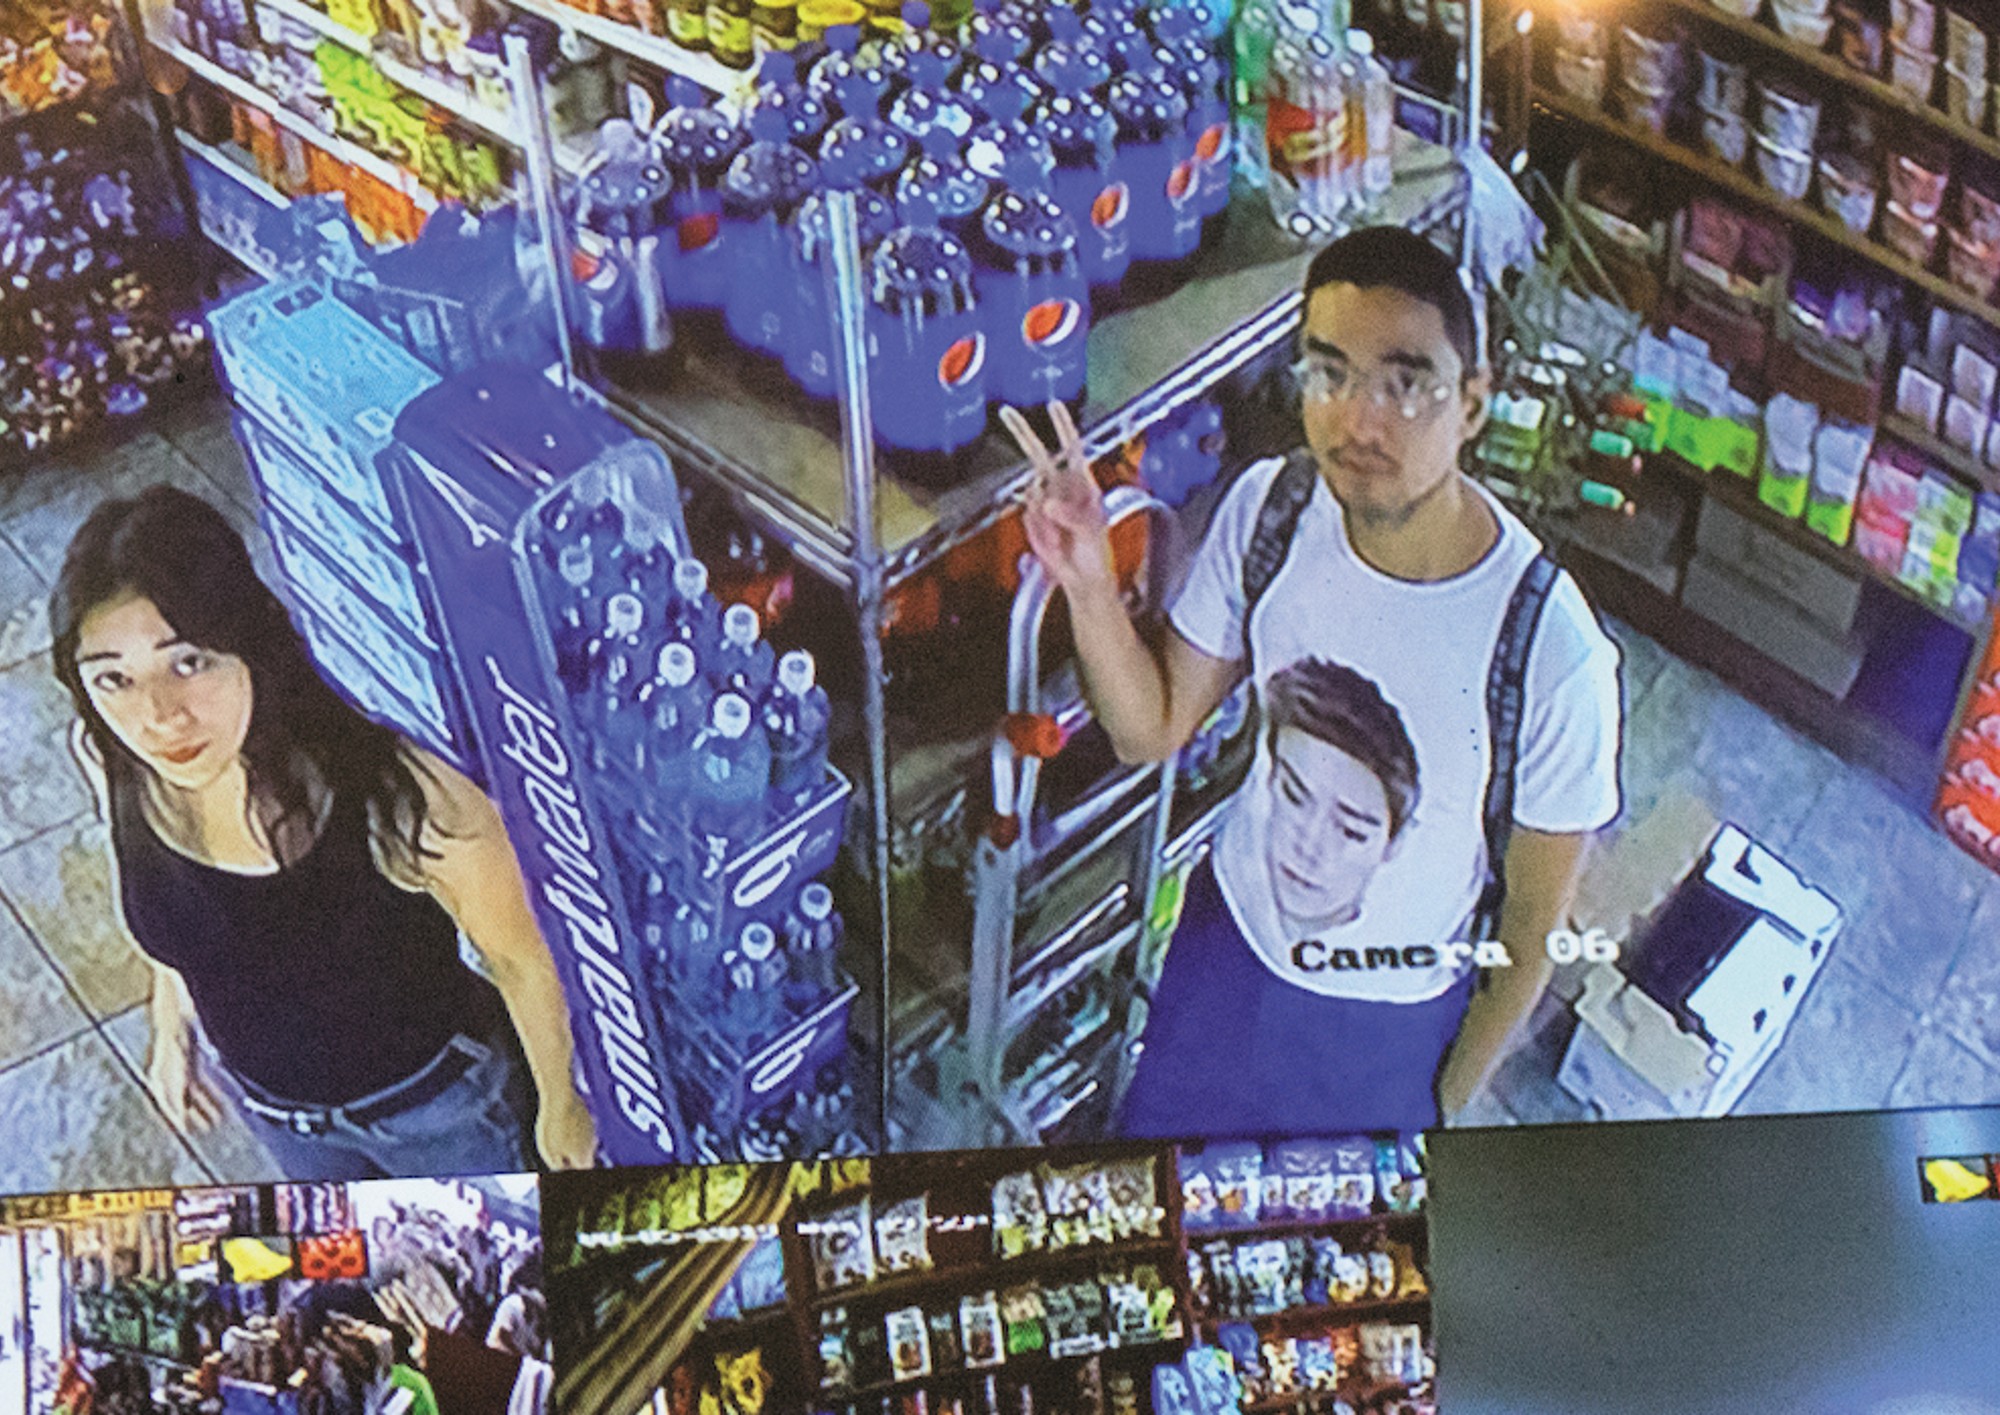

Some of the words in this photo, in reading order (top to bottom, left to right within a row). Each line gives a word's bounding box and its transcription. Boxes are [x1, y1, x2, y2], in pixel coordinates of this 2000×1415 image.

[485, 655, 674, 1154] smartwater
[1291, 938, 1513, 971] Camera
[1545, 928, 1619, 964] 06
